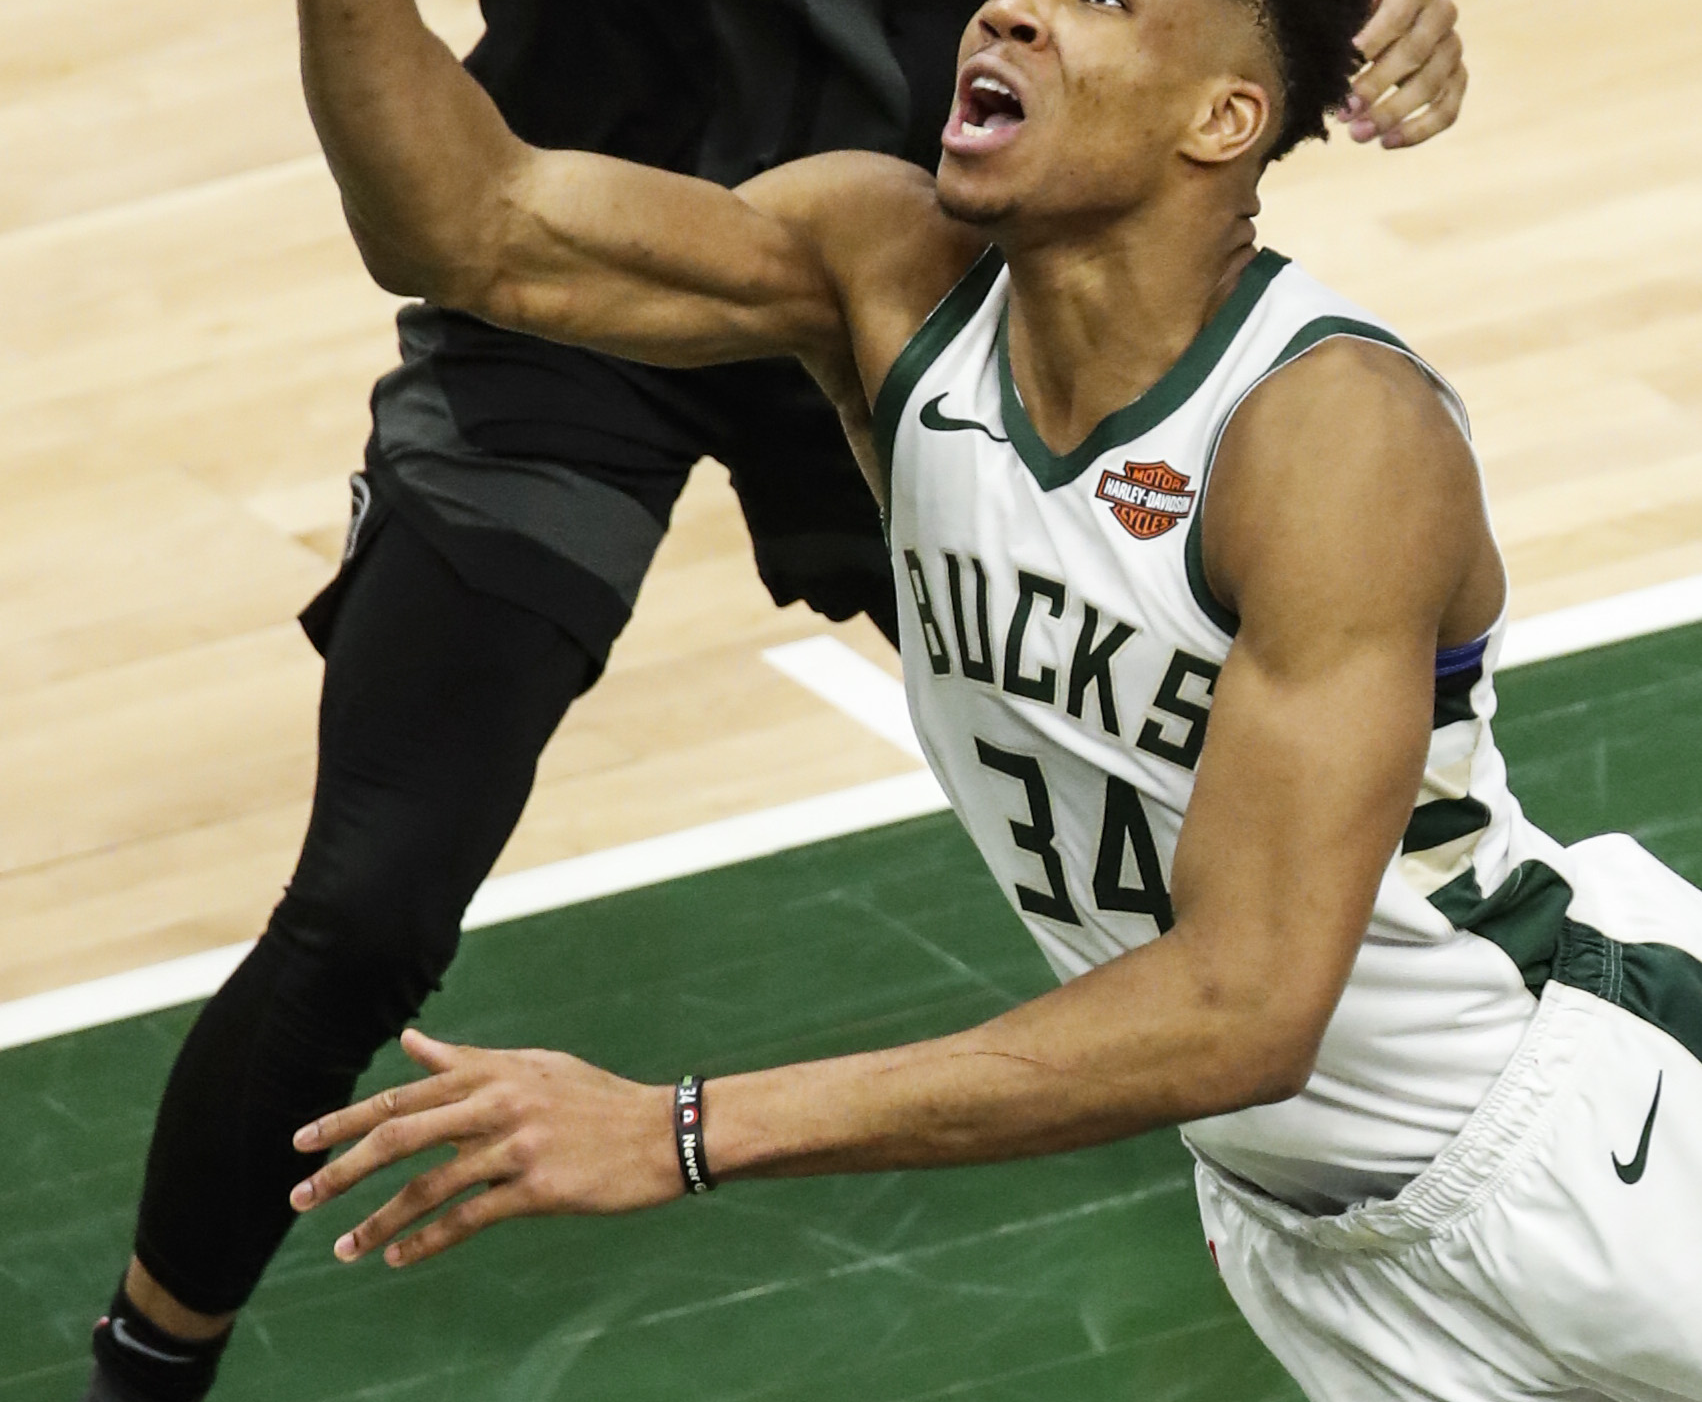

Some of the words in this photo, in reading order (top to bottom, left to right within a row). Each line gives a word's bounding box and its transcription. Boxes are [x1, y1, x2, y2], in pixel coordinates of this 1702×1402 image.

[1132, 468, 1181, 490] MOTOR
[1120, 507, 1170, 535] CYCLES
[903, 546, 1224, 772] BUCKS
[974, 735, 1175, 938] 34
[679, 1087, 696, 1104] 34
[682, 1133, 700, 1181] Never
